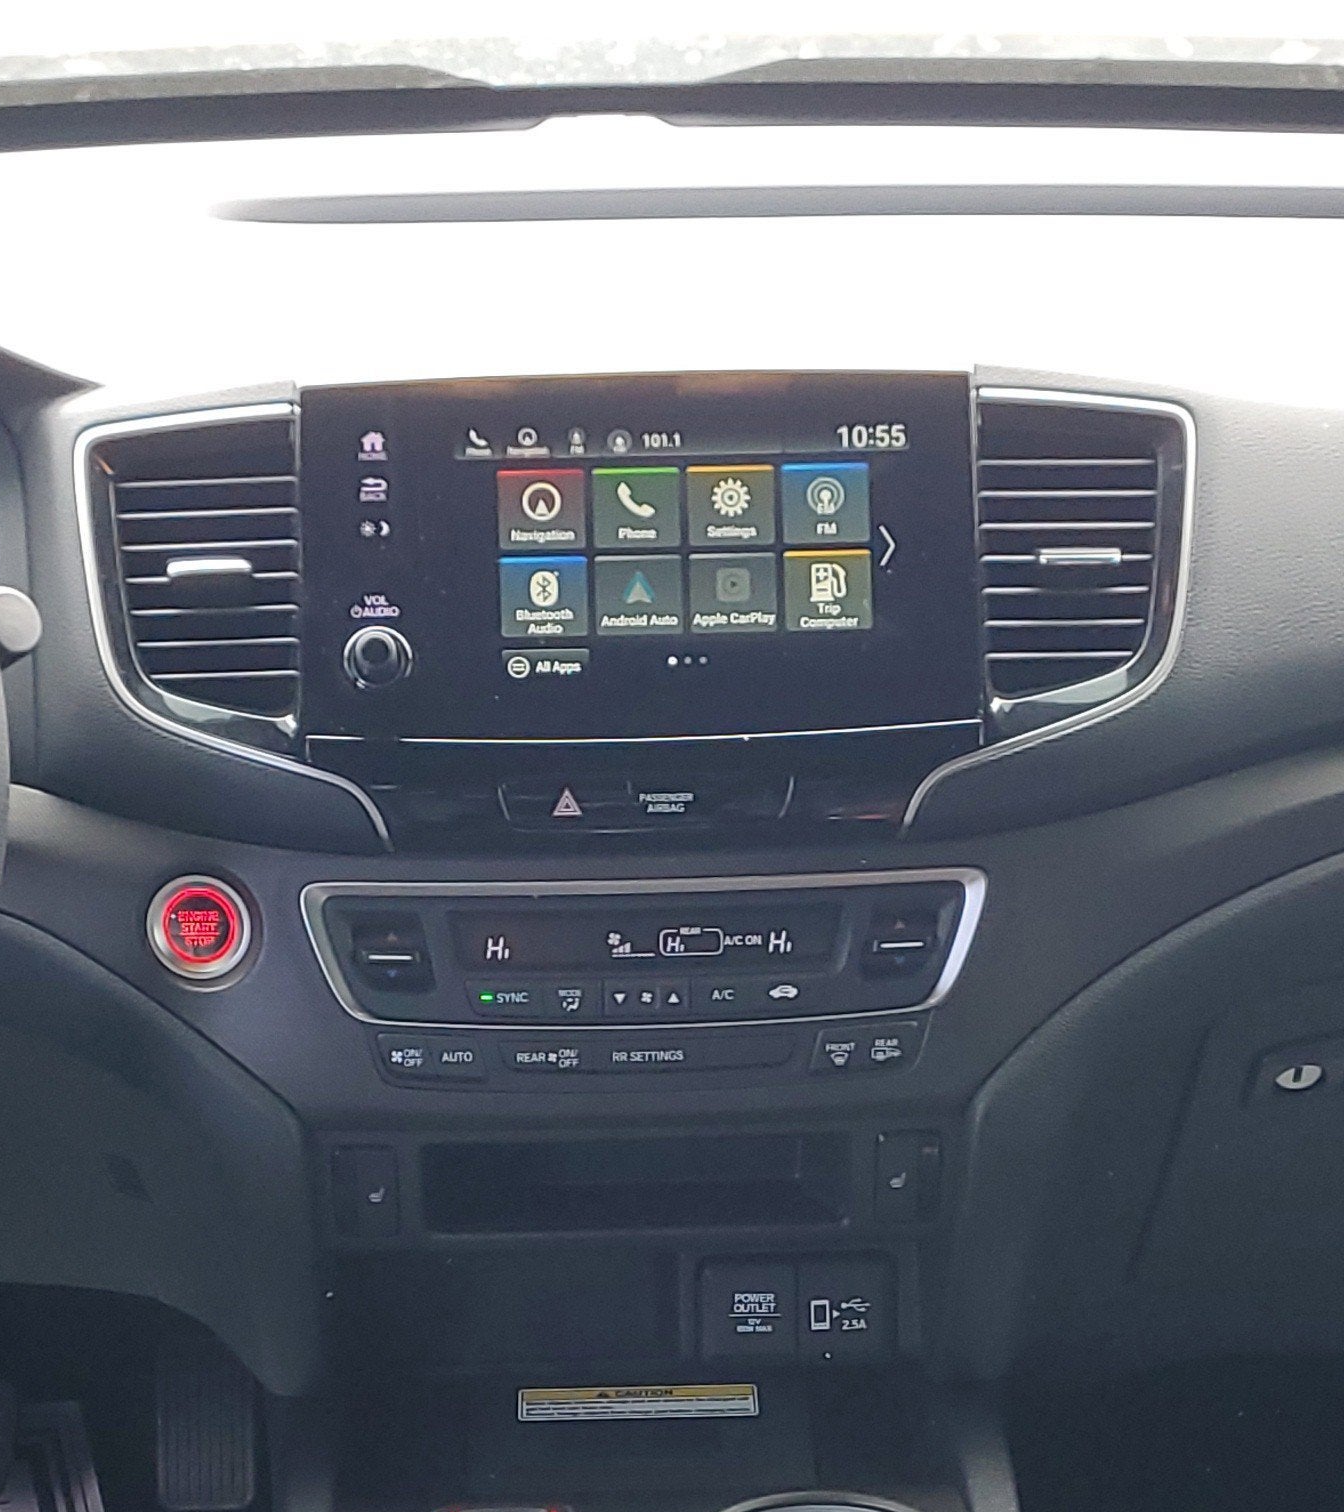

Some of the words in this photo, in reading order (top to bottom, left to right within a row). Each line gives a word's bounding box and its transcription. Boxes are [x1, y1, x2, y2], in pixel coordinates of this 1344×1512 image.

[641, 431, 681, 449] 101.1
[837, 424, 907, 449] 10:55
[618, 527, 657, 540] Phone
[707, 525, 757, 538] Settings
[816, 523, 837, 535] FM
[511, 530, 575, 542] Navigation
[363, 595, 389, 606] VOL
[363, 606, 400, 617] AUDIO
[516, 609, 574, 621] Bluetooth
[817, 603, 841, 616] Trip
[601, 615, 647, 628] Android
[650, 614, 679, 627] Auto
[693, 613, 728, 627] Apple
[730, 611, 776, 626] CarPlay
[800, 616, 858, 629] Computer
[528, 622, 563, 635] Audio
[535, 660, 551, 673] All
[553, 660, 582, 674] Apps
[181, 922, 216, 932] START
[724, 932, 743, 946] A/C
[496, 992, 529, 1004] SYNC
[711, 988, 735, 1001] A/C
[825, 1043, 855, 1053] FRONT
[874, 1039, 899, 1048] REAR
[441, 1051, 473, 1063] AUTO
[516, 1052, 546, 1063] REAR
[612, 1052, 628, 1062] RR
[629, 1050, 684, 1062] SETTINGS
[403, 1058, 423, 1068] OFF
[558, 1058, 579, 1069] OFF
[734, 1293, 775, 1303] POWER
[733, 1303, 777, 1313] OUTLET
